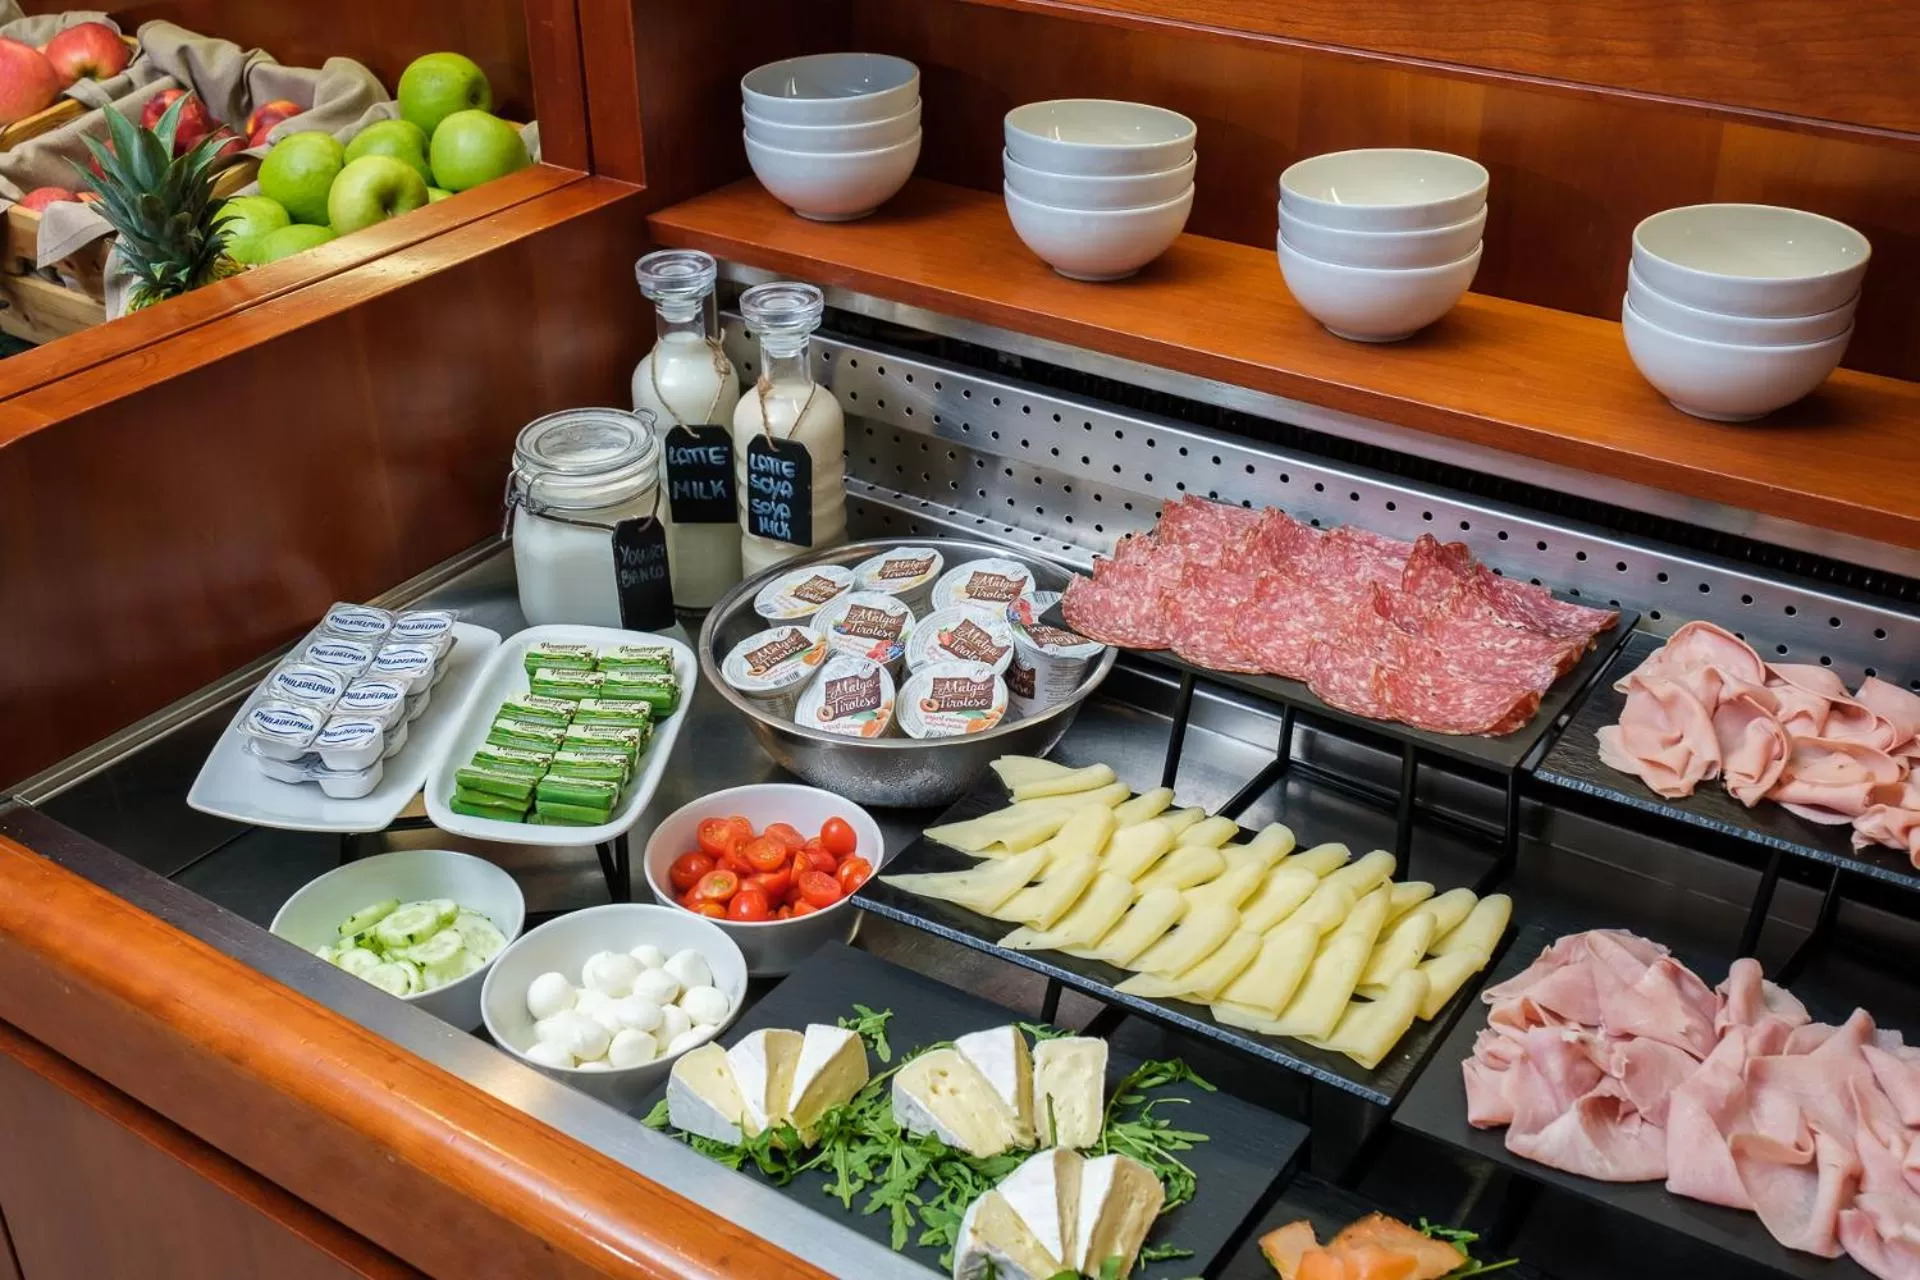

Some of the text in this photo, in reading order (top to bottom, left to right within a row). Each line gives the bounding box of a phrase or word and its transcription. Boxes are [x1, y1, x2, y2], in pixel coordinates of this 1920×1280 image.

[668, 446, 728, 465] LATTE
[750, 453, 796, 479] LATTE
[672, 479, 727, 501] MILK
[750, 473, 794, 501] SOYA
[330, 615, 386, 630] PHILADELPHIA
[392, 622, 447, 631] PHILADELPHIA
[309, 646, 366, 662] PHILADELPHIA
[373, 655, 428, 665] PHILADELPHIA
[278, 674, 337, 696] PHILADELPHIA
[831, 680, 874, 699] Malga
[938, 681, 986, 698] Malga
[342, 690, 398, 701] PHILADELPHIA
[828, 695, 877, 714] Tirolese
[936, 695, 988, 708] Tirolese
[254, 711, 314, 732] PHILADELPHIA
[319, 726, 376, 738] PHILADELPHIA
